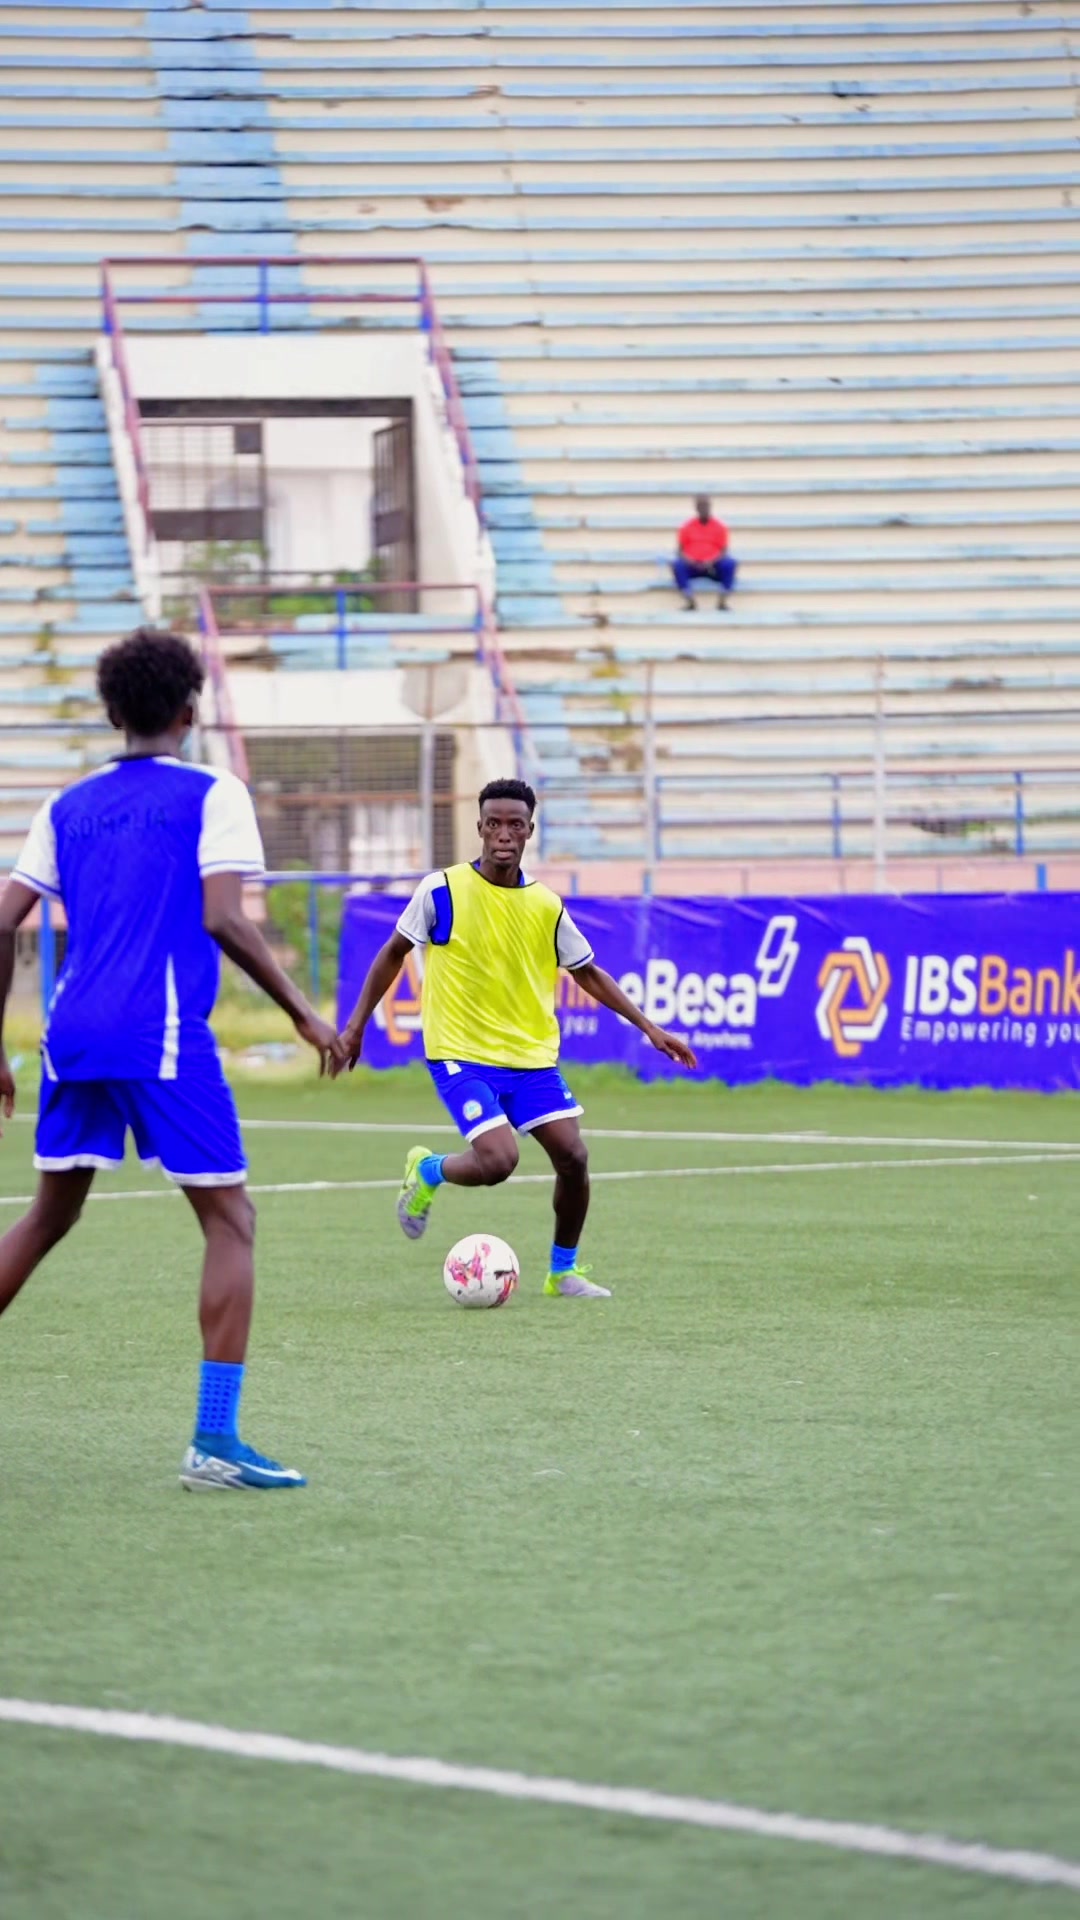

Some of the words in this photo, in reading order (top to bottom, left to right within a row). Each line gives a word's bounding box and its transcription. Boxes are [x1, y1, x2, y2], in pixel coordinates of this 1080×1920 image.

[65, 808, 168, 842] SOMALIA
[616, 958, 757, 1027] eBesa
[903, 949, 1080, 1016] IBSBank
[901, 1016, 1037, 1048] Empowering
